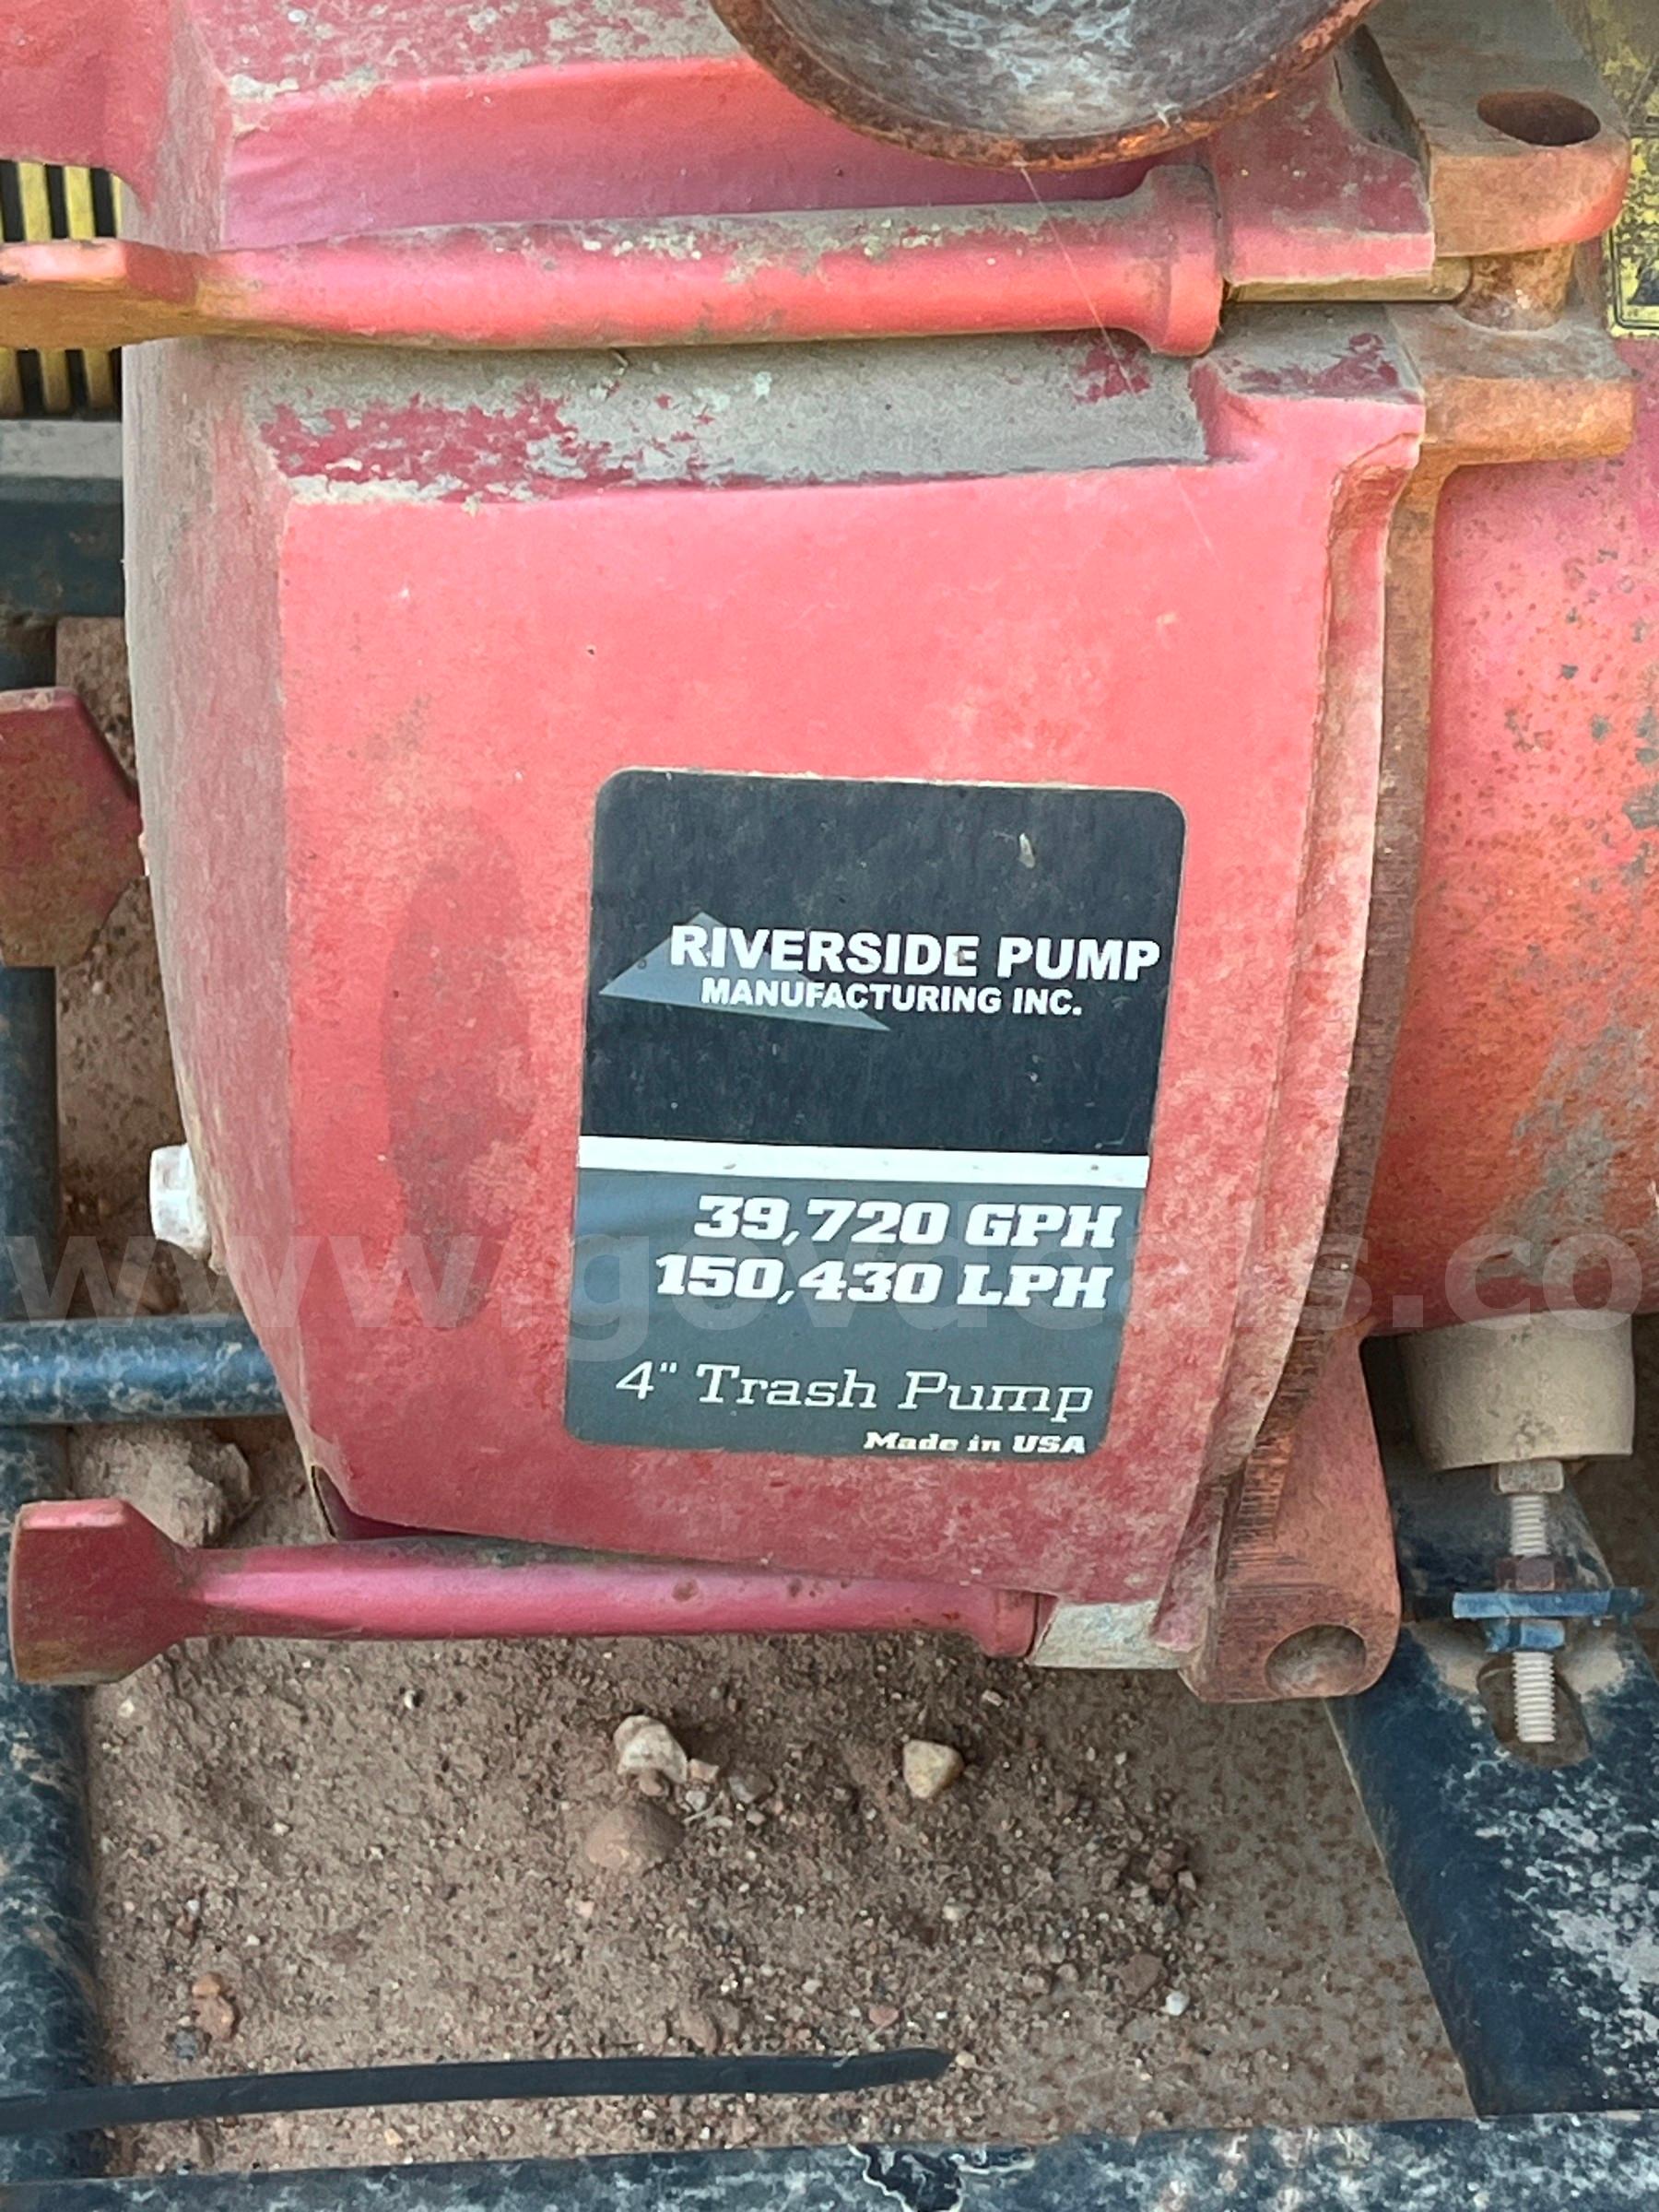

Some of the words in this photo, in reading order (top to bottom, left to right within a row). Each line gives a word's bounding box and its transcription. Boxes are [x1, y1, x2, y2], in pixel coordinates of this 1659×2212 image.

[669, 924, 980, 977] RIVERSIDE
[996, 936, 1160, 982] PUMP
[700, 977, 1003, 1015] MANUFACTURING
[1012, 987, 1082, 1016] INC.
[693, 1194, 950, 1247] 39,720
[963, 1203, 1124, 1249] GPH
[655, 1253, 944, 1305] 150,430
[956, 1264, 1114, 1309] LPH
[615, 1360, 677, 1400] 4"
[696, 1363, 877, 1409] Trash
[897, 1371, 1093, 1423] Pump
[863, 1431, 959, 1452] Made
[966, 1433, 1001, 1453] in
[1012, 1434, 1086, 1454] USA
